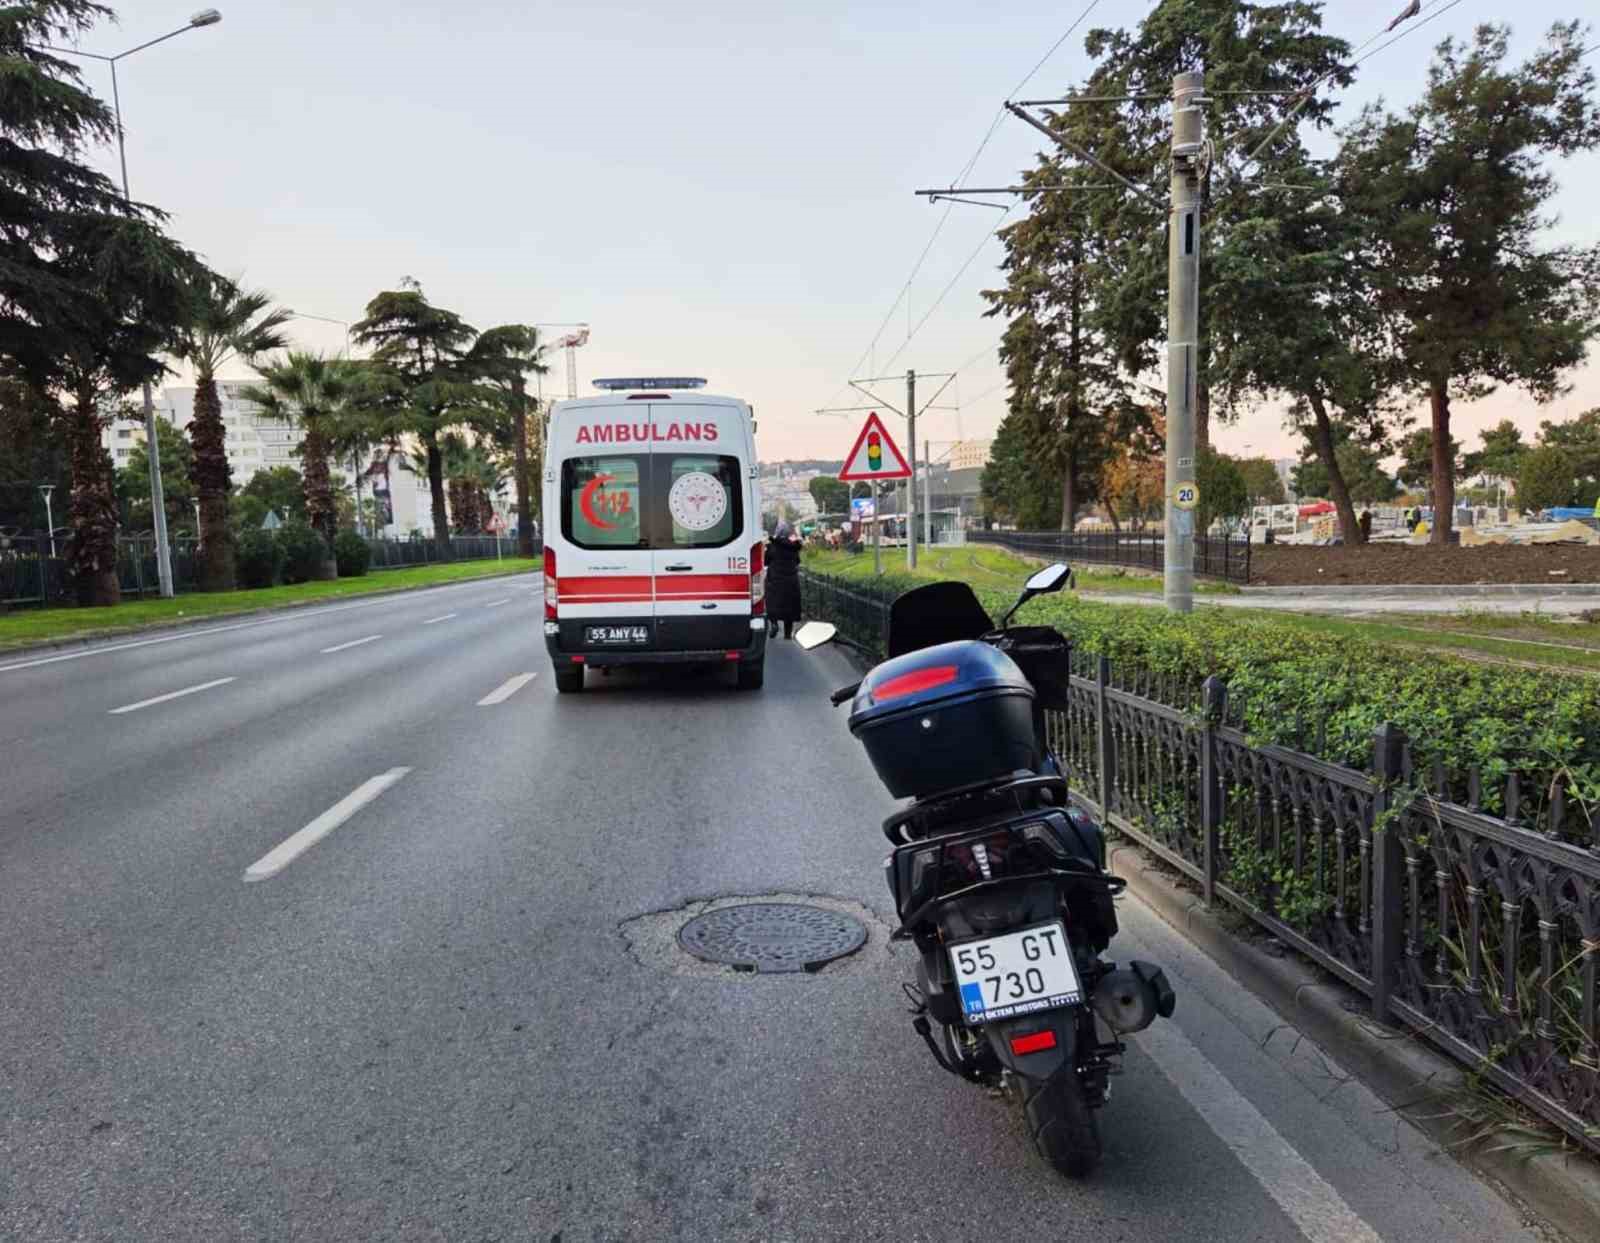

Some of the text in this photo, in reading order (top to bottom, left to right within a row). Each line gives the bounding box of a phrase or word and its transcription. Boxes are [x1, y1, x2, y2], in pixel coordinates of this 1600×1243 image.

[576, 423, 718, 443] AMBULANS
[597, 490, 630, 514] 112
[1179, 489, 1193, 502] 20
[728, 557, 748, 570] 112
[592, 628, 606, 640] 55
[632, 627, 647, 639] 44
[958, 930, 1057, 976] 55 GT
[985, 967, 1045, 1003] 730
[969, 1001, 983, 1011] TR
